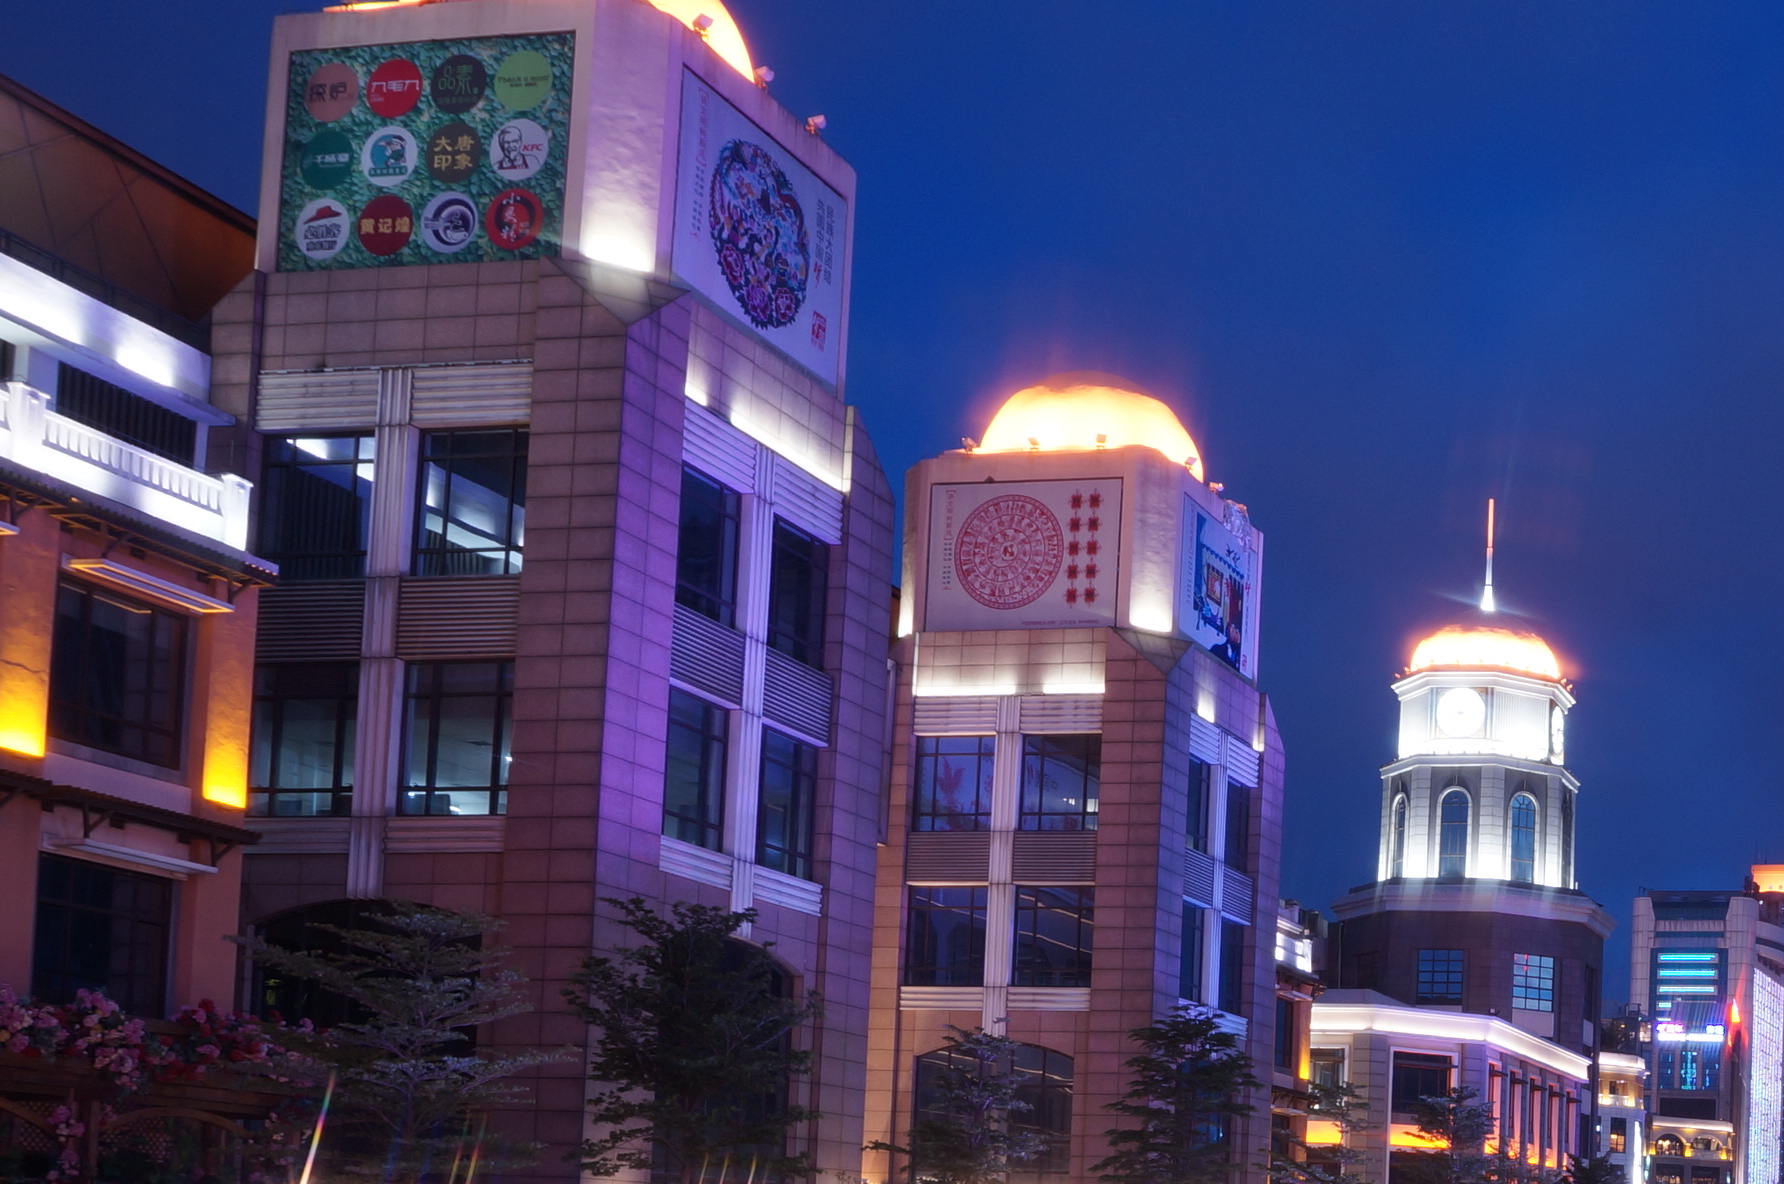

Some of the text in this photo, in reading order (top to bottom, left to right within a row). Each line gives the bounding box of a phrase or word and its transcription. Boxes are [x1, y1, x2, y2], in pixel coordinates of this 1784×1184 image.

[371, 80, 419, 93] 九毛九
[433, 134, 475, 152] 大唐
[522, 144, 542, 152] KFC
[433, 153, 473, 170] 印象
